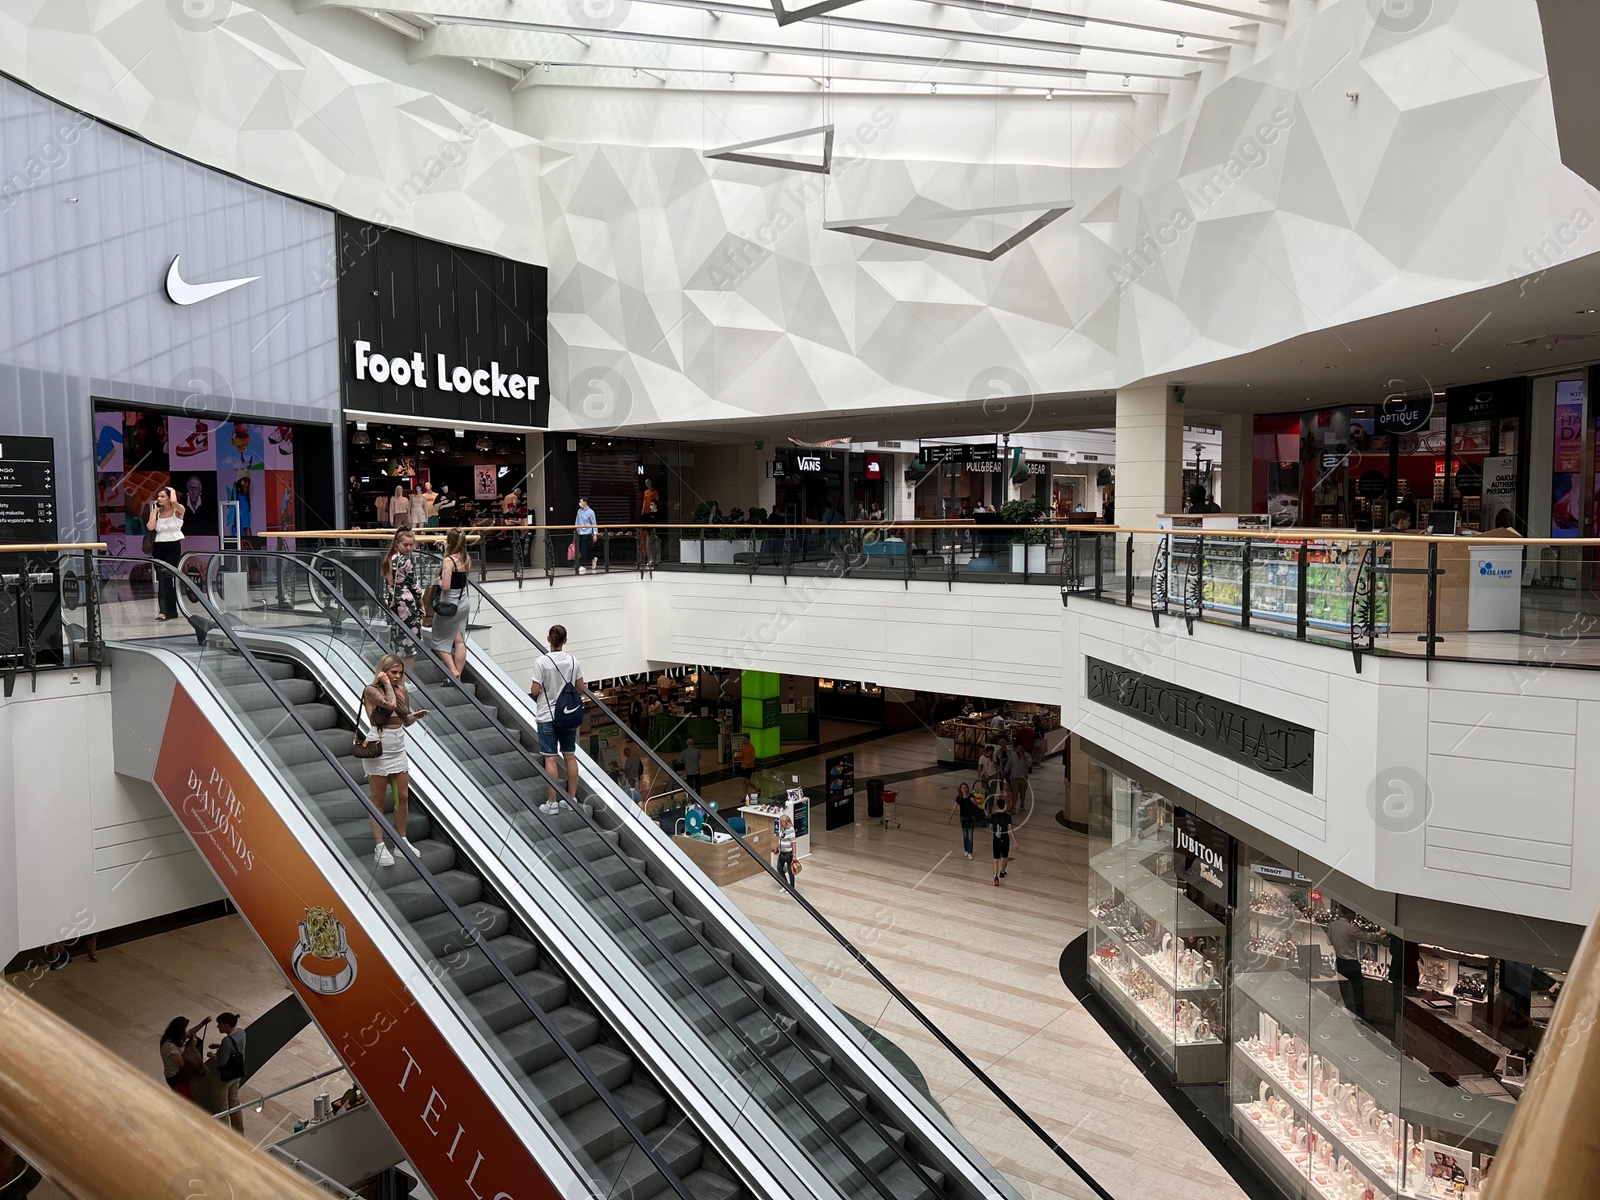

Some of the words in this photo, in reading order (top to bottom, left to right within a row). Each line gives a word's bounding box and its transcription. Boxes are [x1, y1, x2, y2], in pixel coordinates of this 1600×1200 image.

[354, 340, 427, 388] Foot
[437, 353, 540, 400] Locker
[1380, 410, 1419, 426] OPTIQUE
[797, 456, 821, 471] VANS
[966, 462, 1001, 473] PULL&BEAR
[1098, 665, 1297, 772] WSZECHŚWIAT
[187, 768, 255, 871] DIAMONDS
[209, 766, 245, 824] PURE
[1176, 827, 1224, 872] JUBITOM
[1260, 866, 1282, 875] TISSOT
[398, 1046, 515, 1200] TEIL
